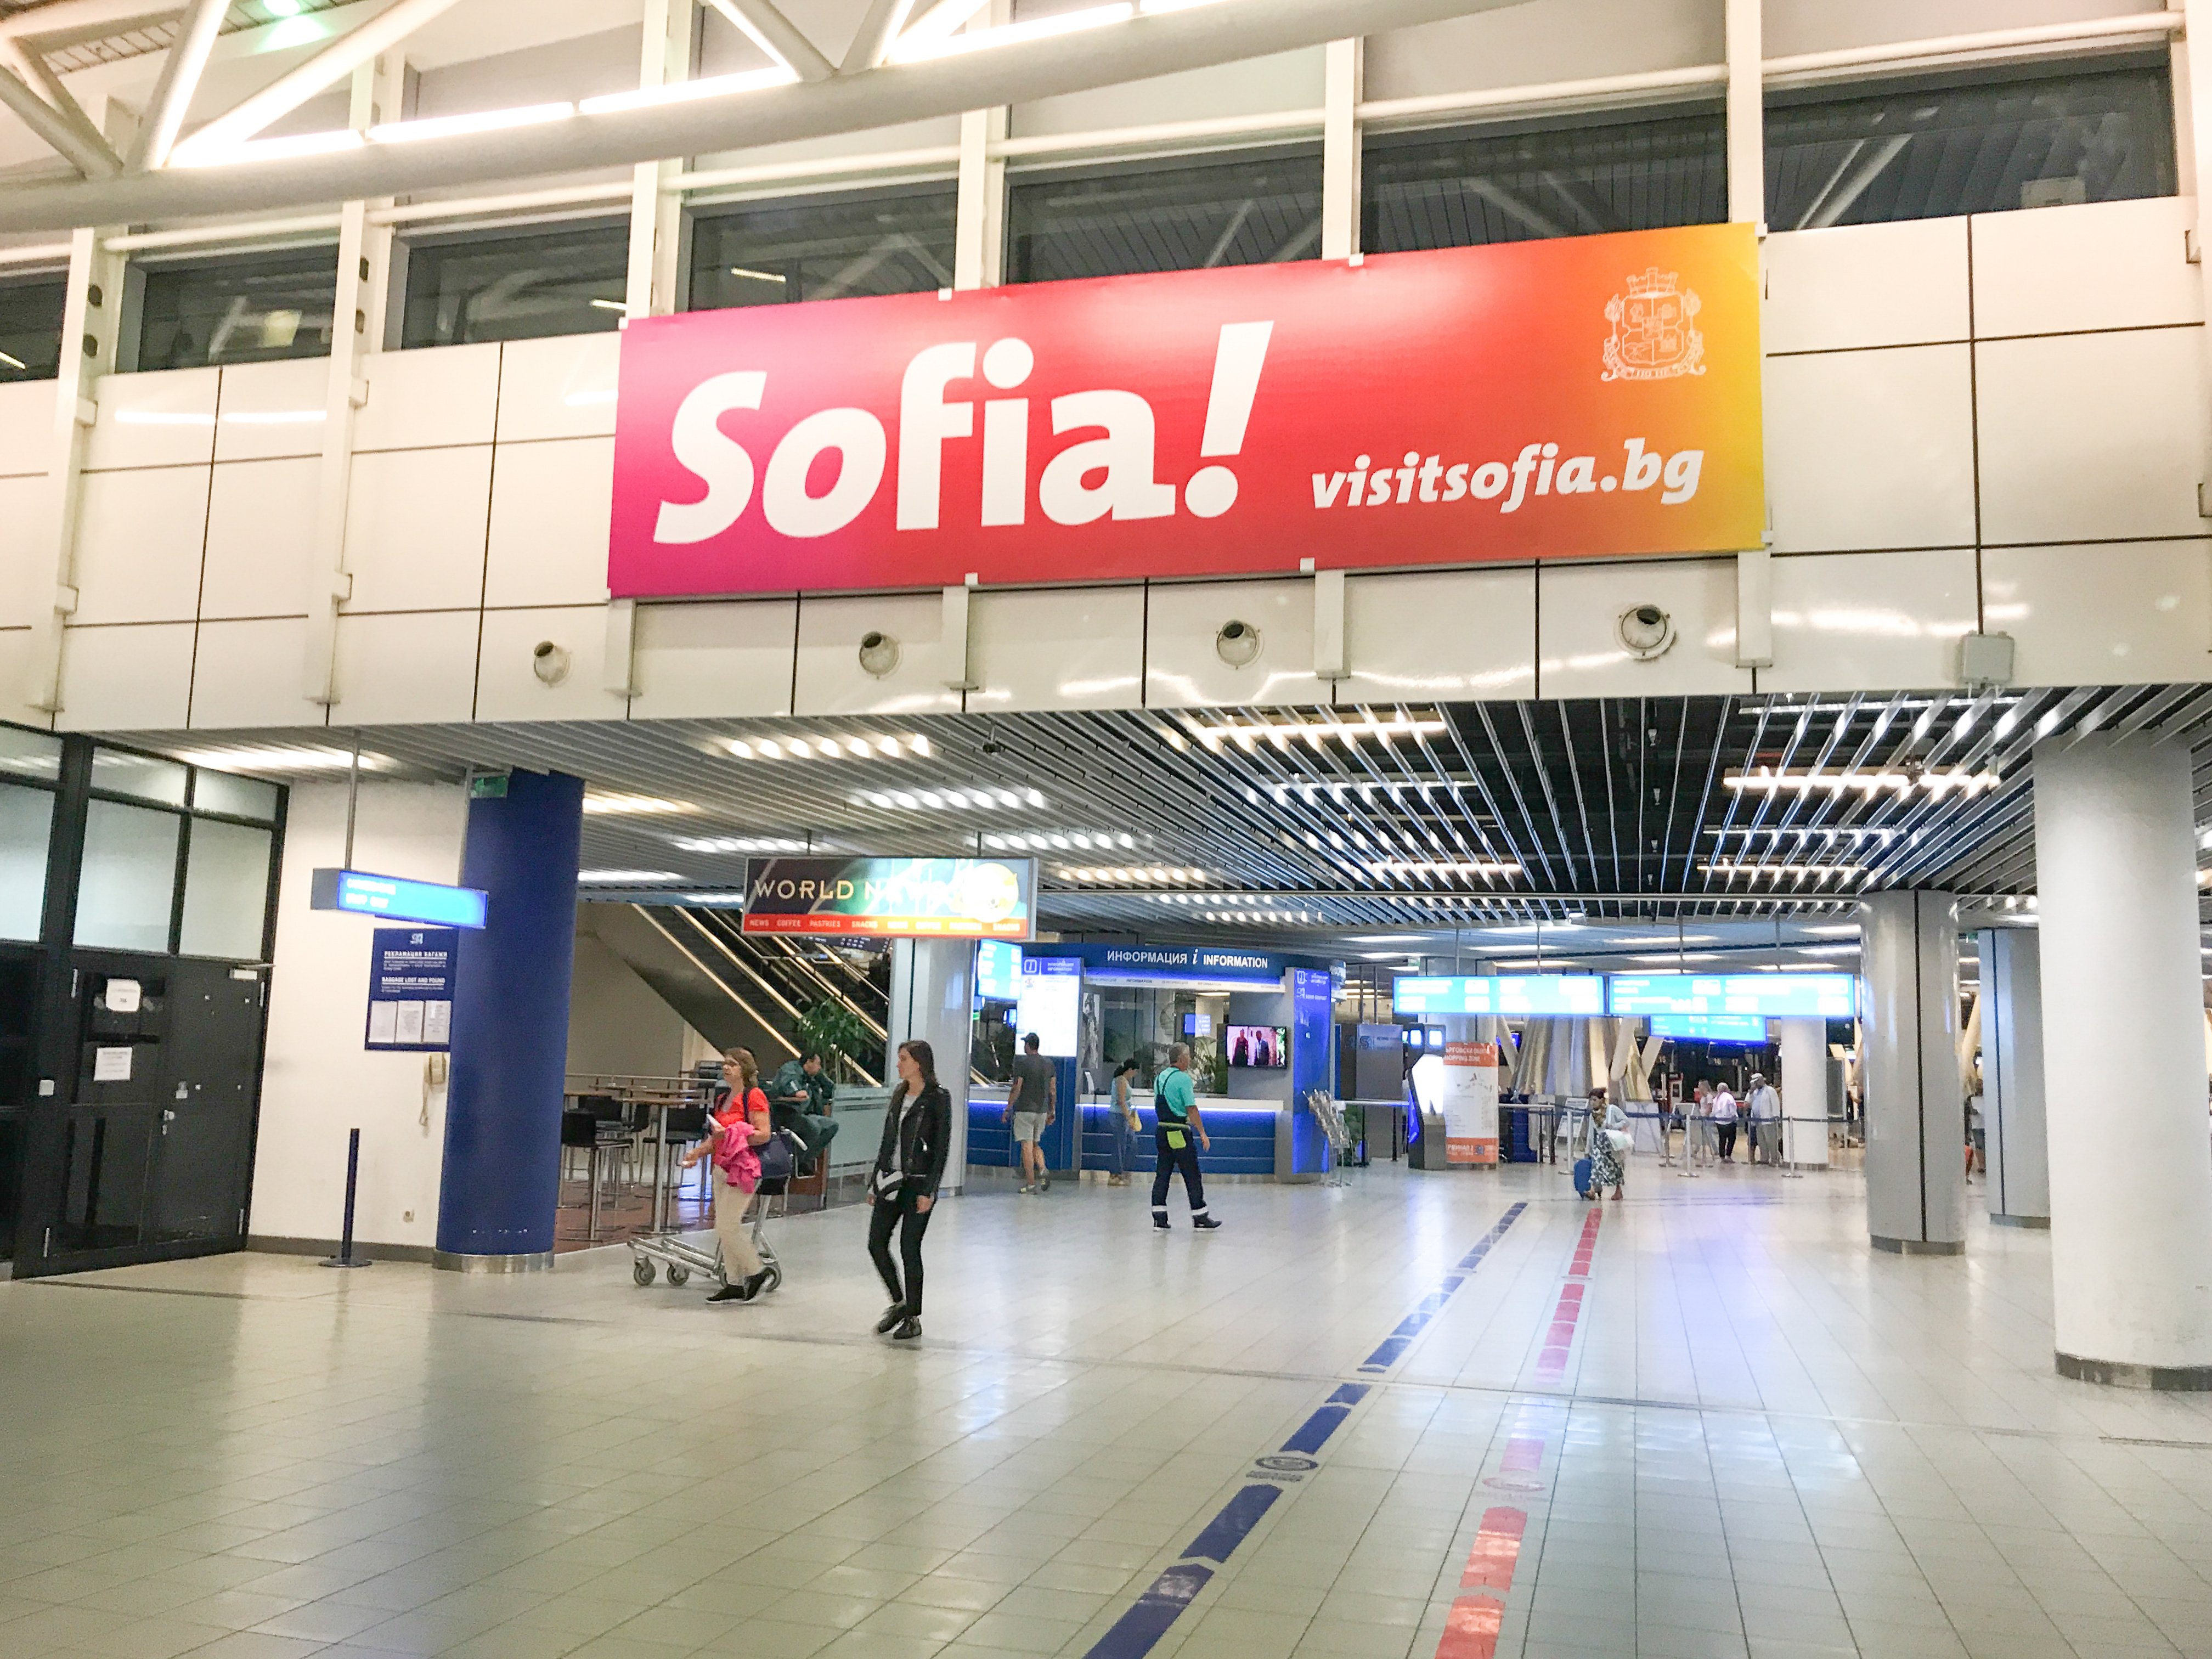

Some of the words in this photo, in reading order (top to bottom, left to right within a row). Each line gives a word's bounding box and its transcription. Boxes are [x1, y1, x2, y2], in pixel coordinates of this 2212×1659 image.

[653, 320, 1274, 544] Sofia!
[1312, 437, 1704, 514] visitsofia.bg
[754, 879, 854, 900] WORLD
[851, 920, 878, 929] SNACKS
[1107, 950, 1187, 965] ИНФОРМАЦИЯ
[1203, 954, 1268, 969] INFORMATION
